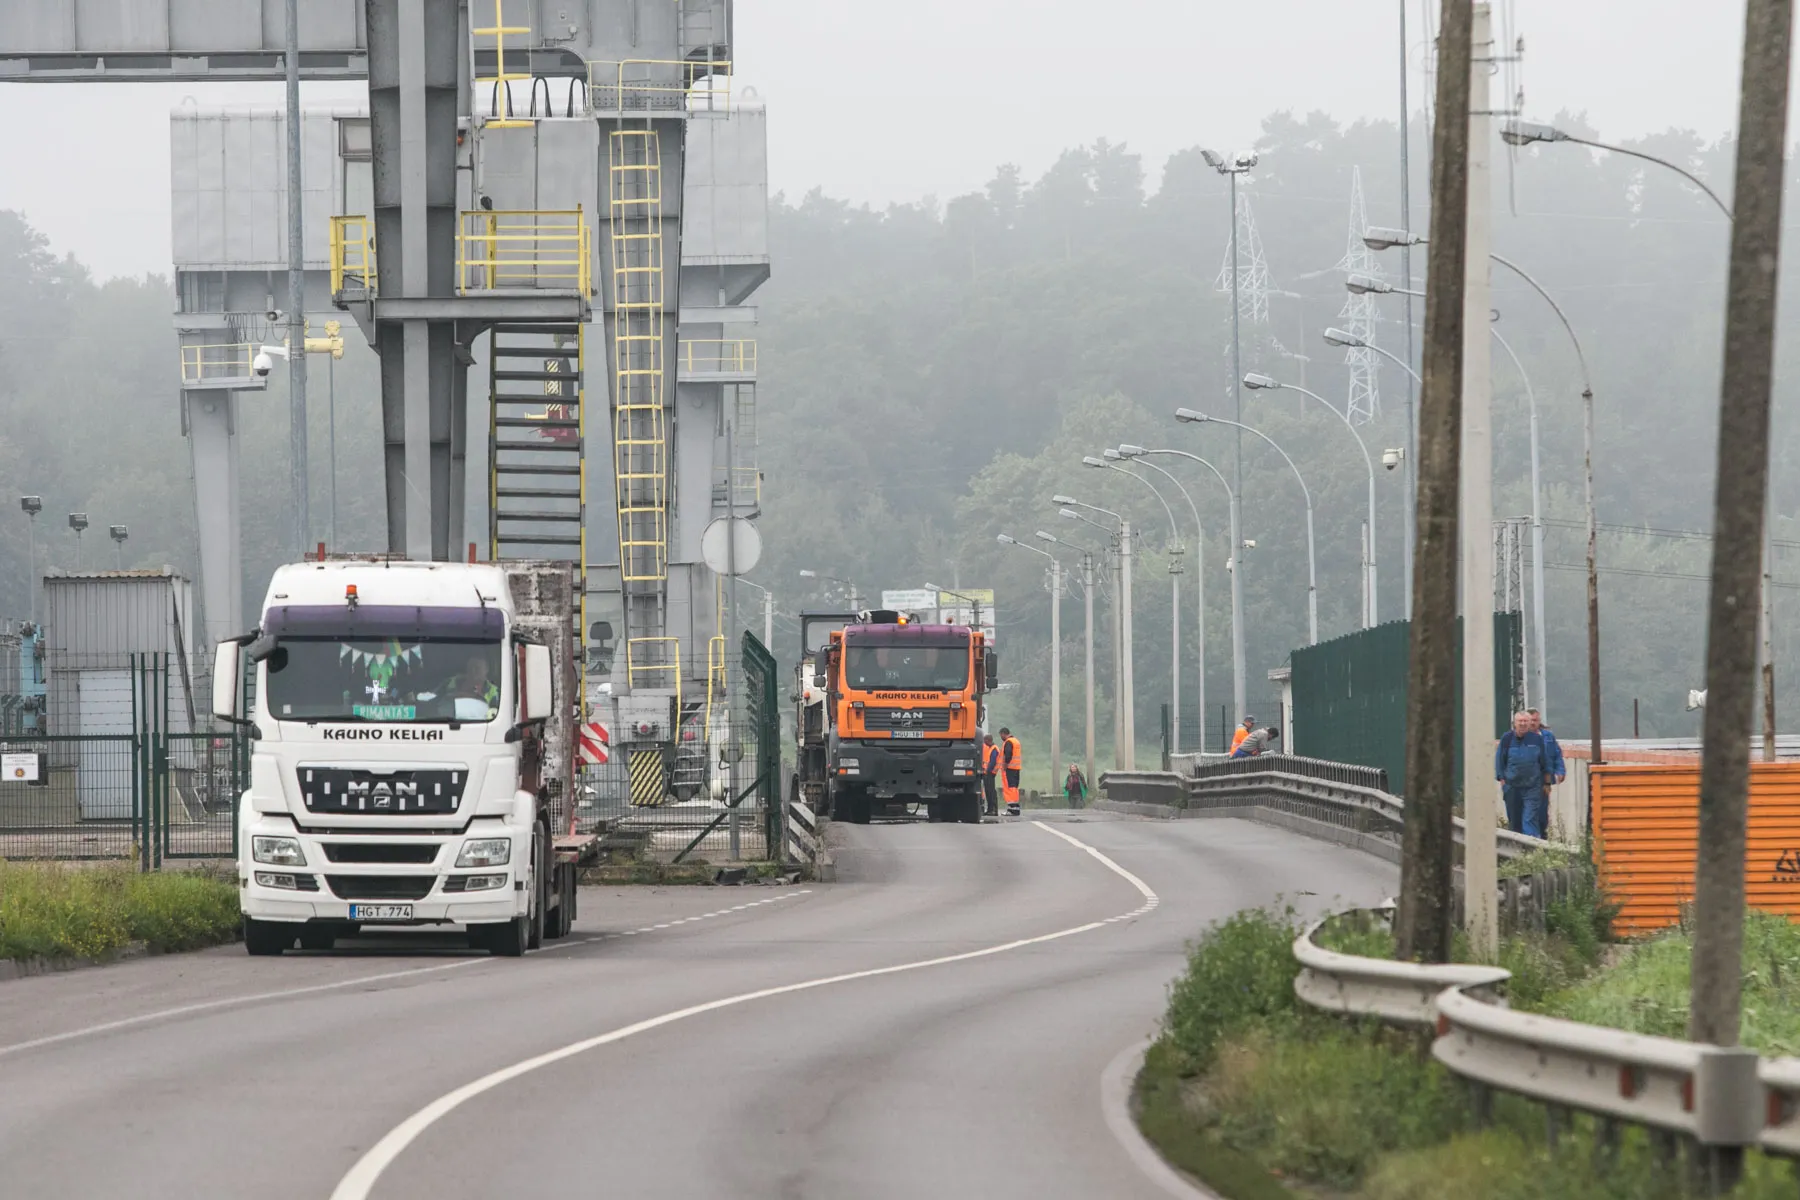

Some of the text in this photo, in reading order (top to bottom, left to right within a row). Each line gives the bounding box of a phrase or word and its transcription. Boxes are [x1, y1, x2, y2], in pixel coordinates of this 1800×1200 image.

[891, 711, 923, 719] MAN
[323, 729, 443, 741] KAUNO KELIAI
[348, 781, 417, 796] MAN
[357, 906, 410, 917] HGT 774
